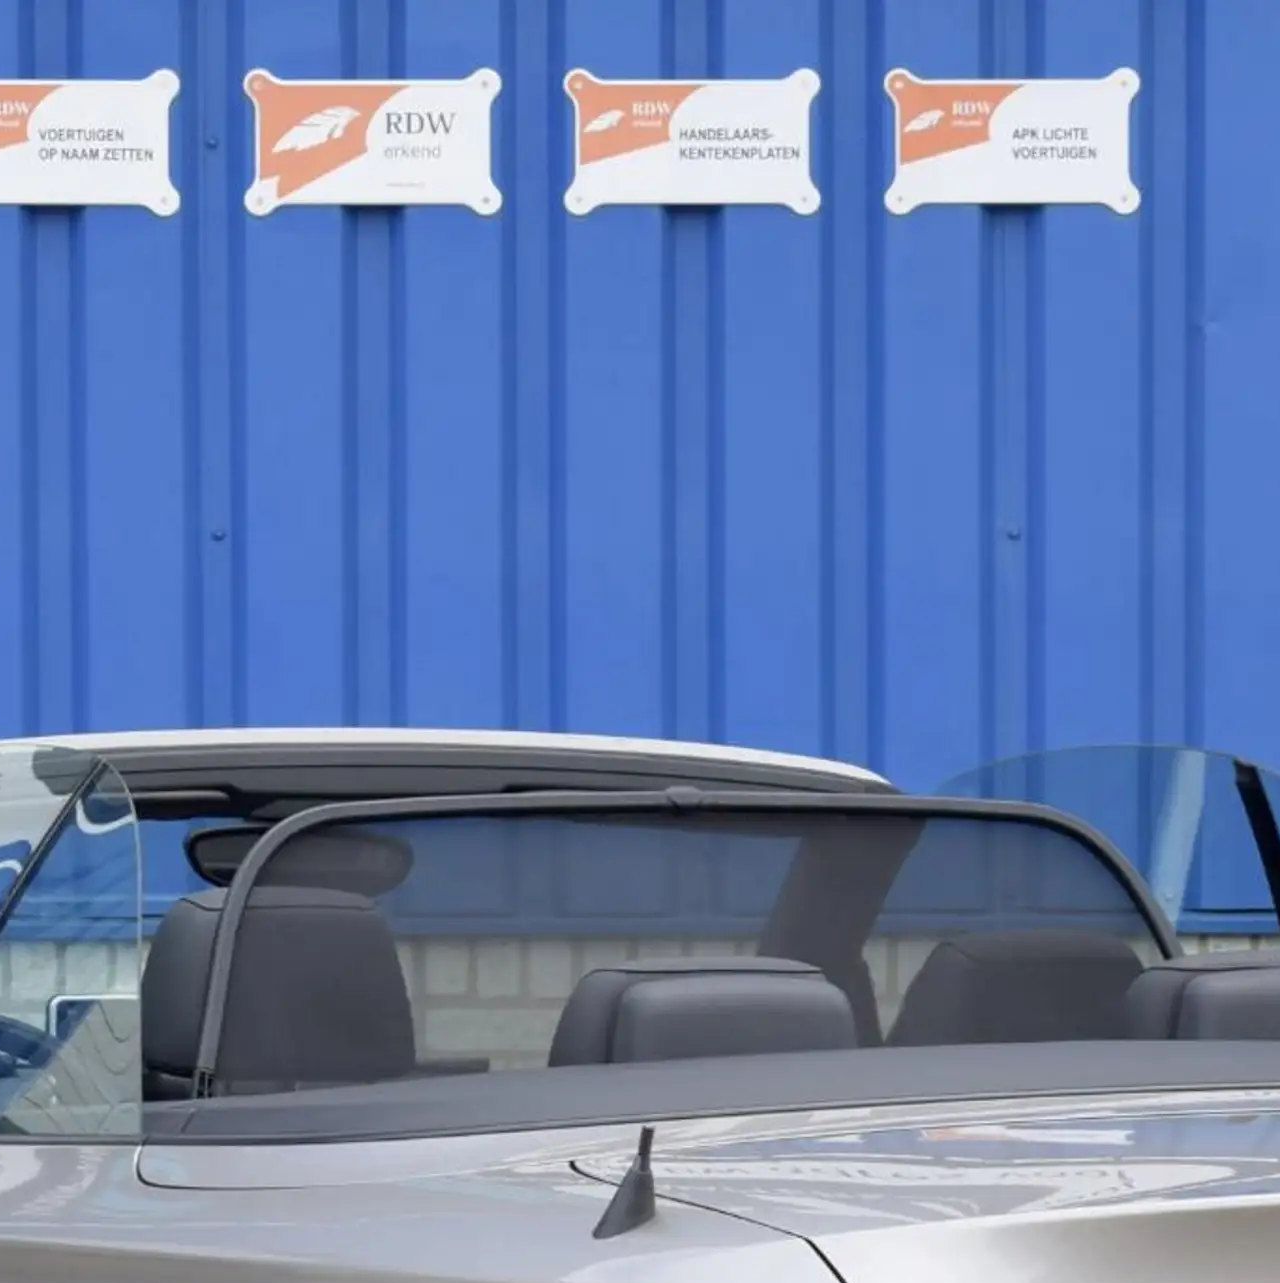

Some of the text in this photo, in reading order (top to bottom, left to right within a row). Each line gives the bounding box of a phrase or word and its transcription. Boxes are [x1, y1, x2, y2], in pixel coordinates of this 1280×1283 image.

[631, 101, 672, 116] RDW
[951, 100, 991, 116] RDW
[385, 112, 457, 135] RDW
[38, 128, 125, 142] VOERTUIGEN
[678, 127, 775, 141] HANDELAARS-
[1011, 127, 1089, 141] APK LICHTE
[38, 147, 154, 162] OP NAAM ZETTEN
[383, 143, 441, 160] erkend
[678, 146, 801, 160] KENTEKENPLATEN
[1011, 146, 1098, 160] VOERTUIGEN
